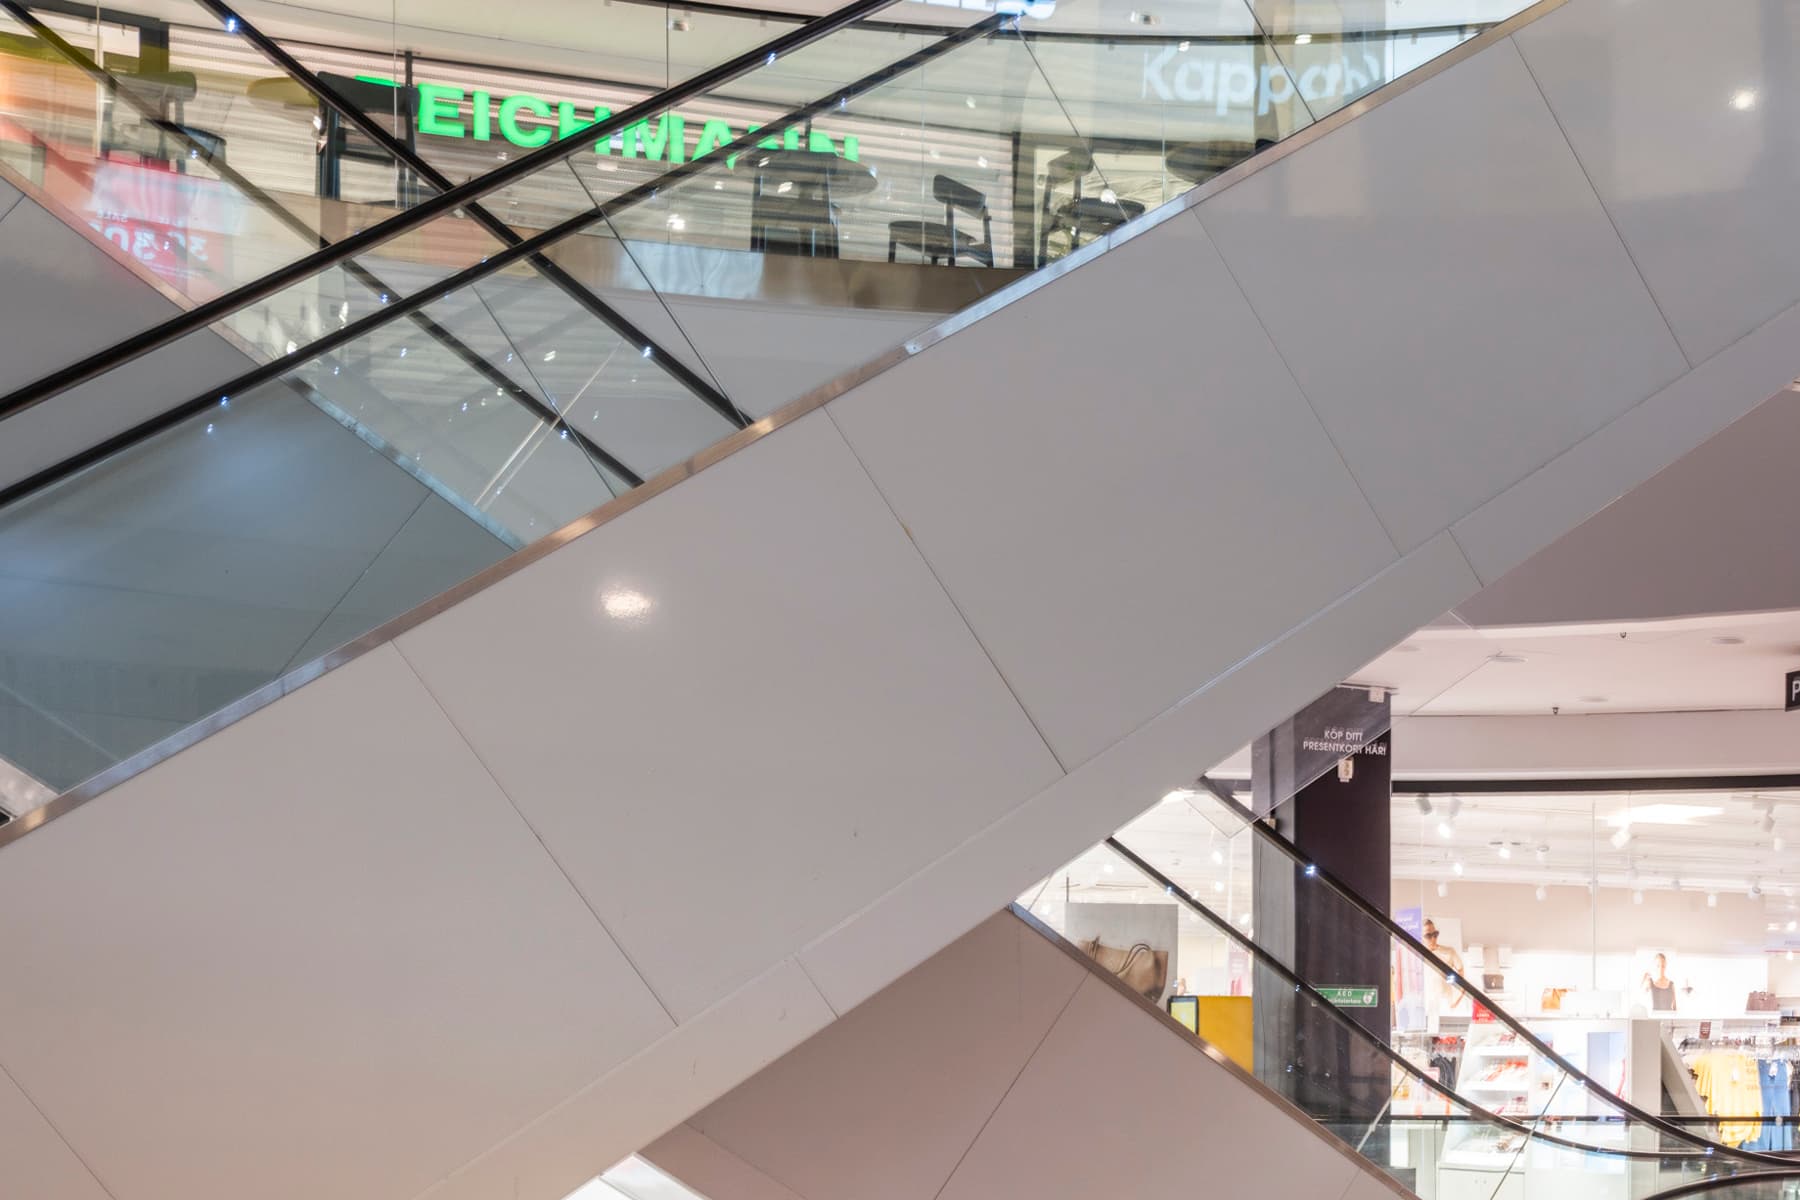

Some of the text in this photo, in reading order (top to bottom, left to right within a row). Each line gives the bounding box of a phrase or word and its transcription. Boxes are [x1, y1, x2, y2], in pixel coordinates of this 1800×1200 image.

[355, 75, 860, 170] EICHMAN
[1324, 729, 1363, 741] KÖP DITT
[1303, 741, 1363, 754] PRESENTKORT
